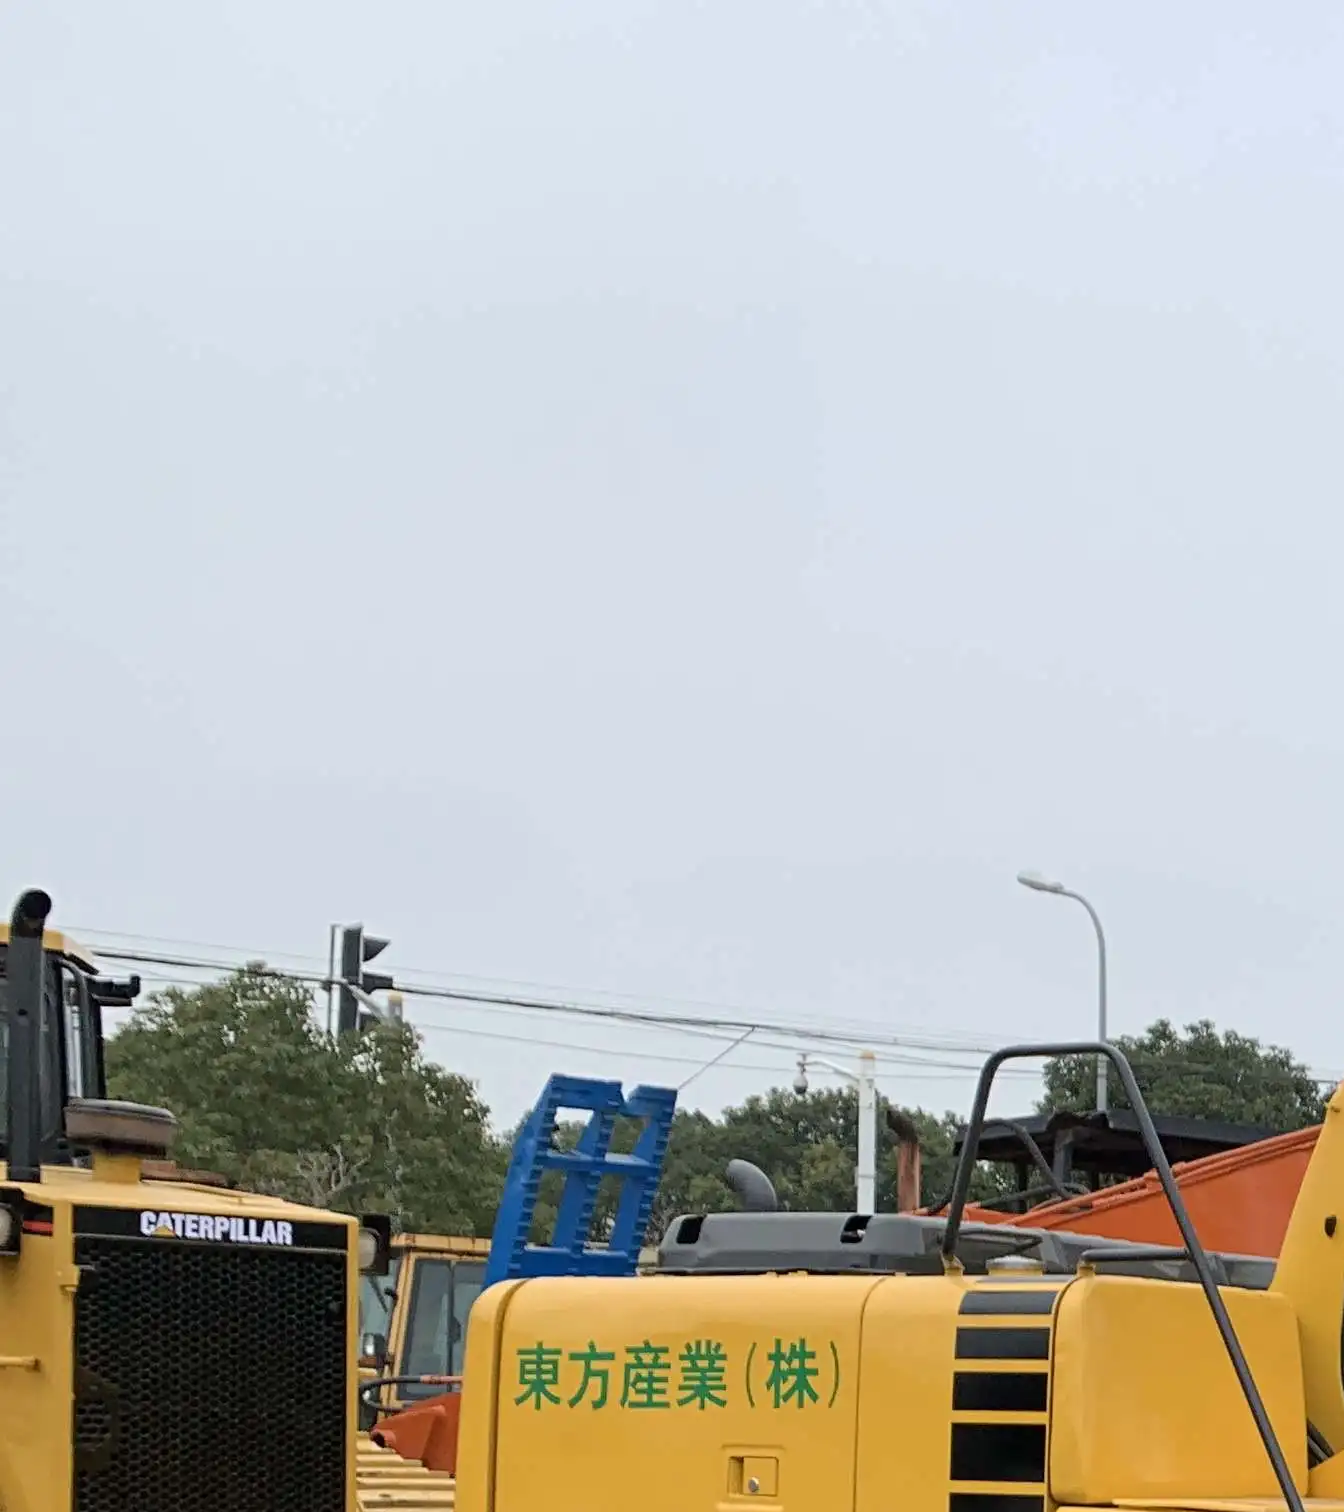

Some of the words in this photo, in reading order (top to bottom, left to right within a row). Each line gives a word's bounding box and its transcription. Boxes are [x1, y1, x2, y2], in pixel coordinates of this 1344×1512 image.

[140, 1210, 293, 1246] CATERPILLAR
[513, 1337, 840, 1411] 東方産業(株)
